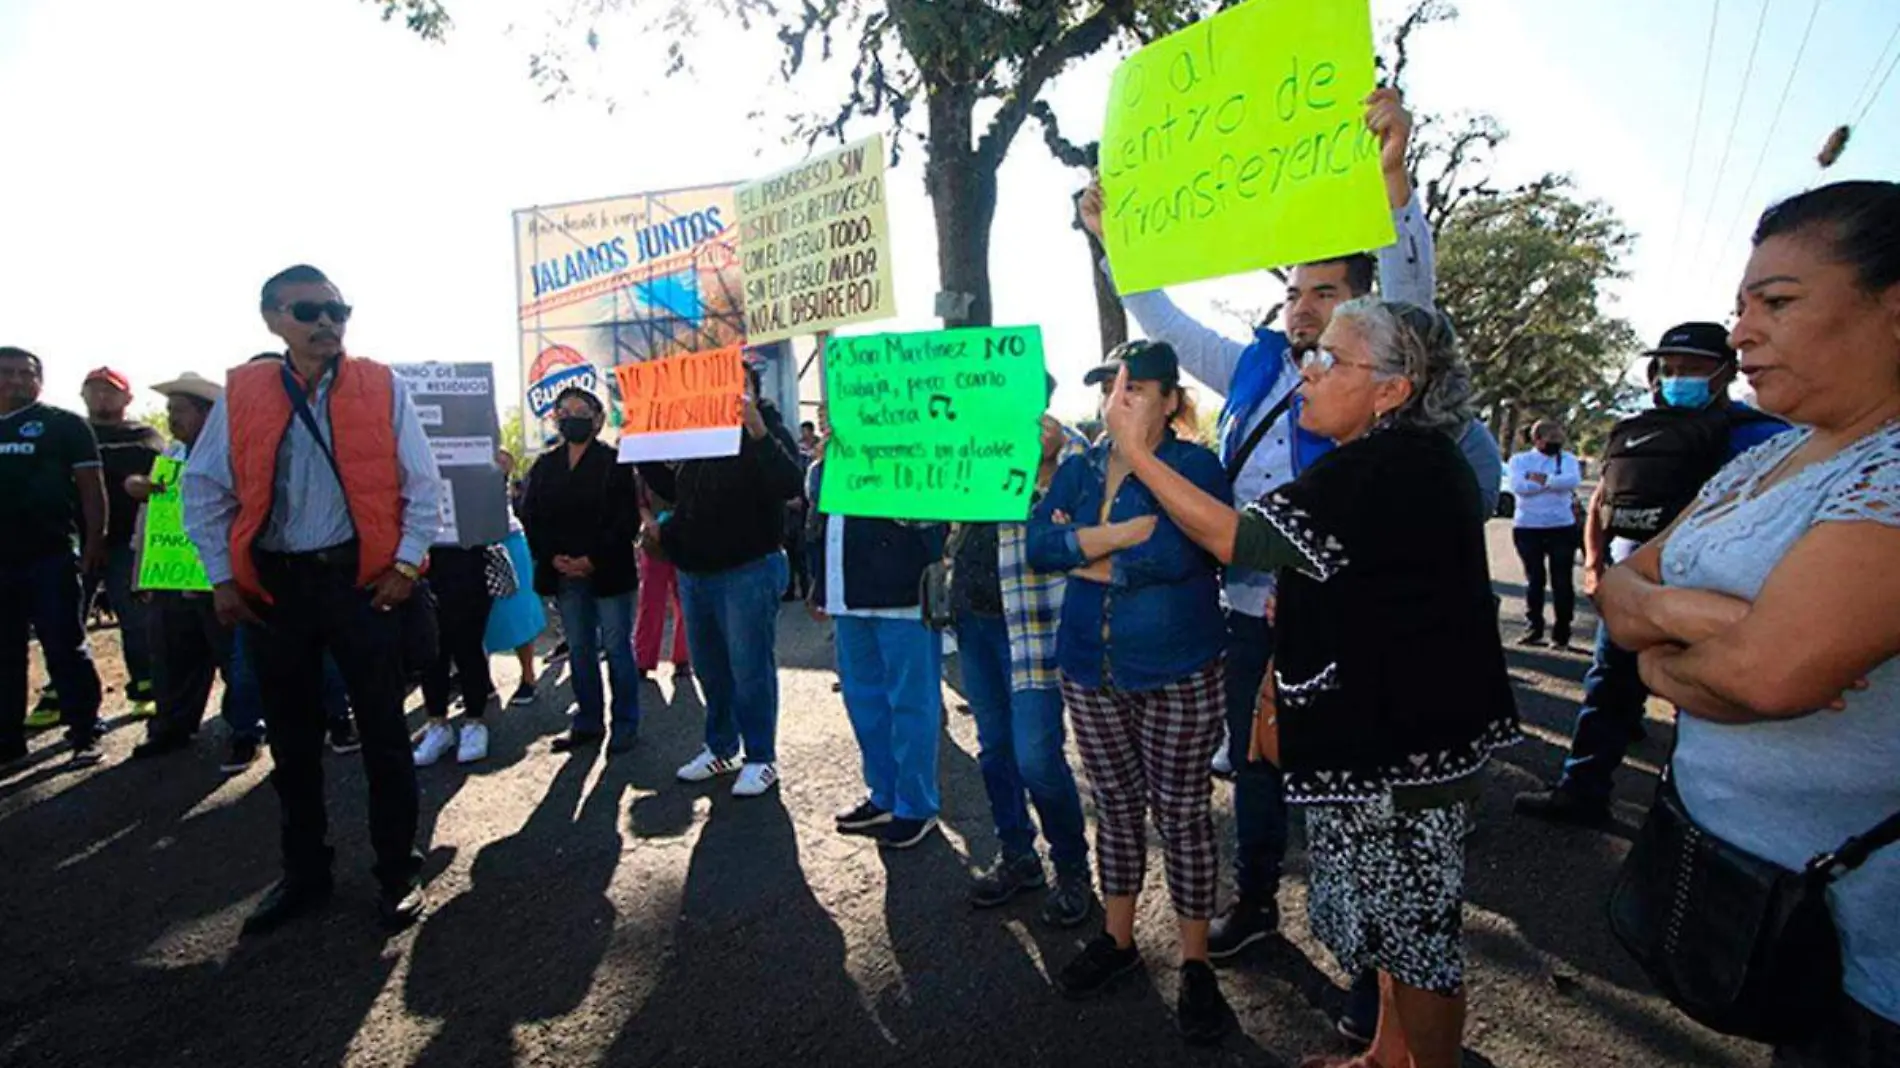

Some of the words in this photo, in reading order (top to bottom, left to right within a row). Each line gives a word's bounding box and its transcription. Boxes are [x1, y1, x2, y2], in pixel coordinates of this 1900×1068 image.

[1123, 62, 1145, 109] O
[1168, 21, 1217, 95] al
[1276, 56, 1336, 121] de
[741, 190, 759, 215] EL
[761, 158, 833, 207] PROGRESO
[838, 146, 865, 180] SIN
[530, 236, 629, 298] JALAMOS
[635, 206, 725, 264] JUNTOS
[779, 227, 827, 263] PUEBLO
[779, 260, 827, 295] PUEBLO
[746, 304, 769, 335] NO
[769, 300, 788, 330] AL
[984, 335, 1026, 361] NO
